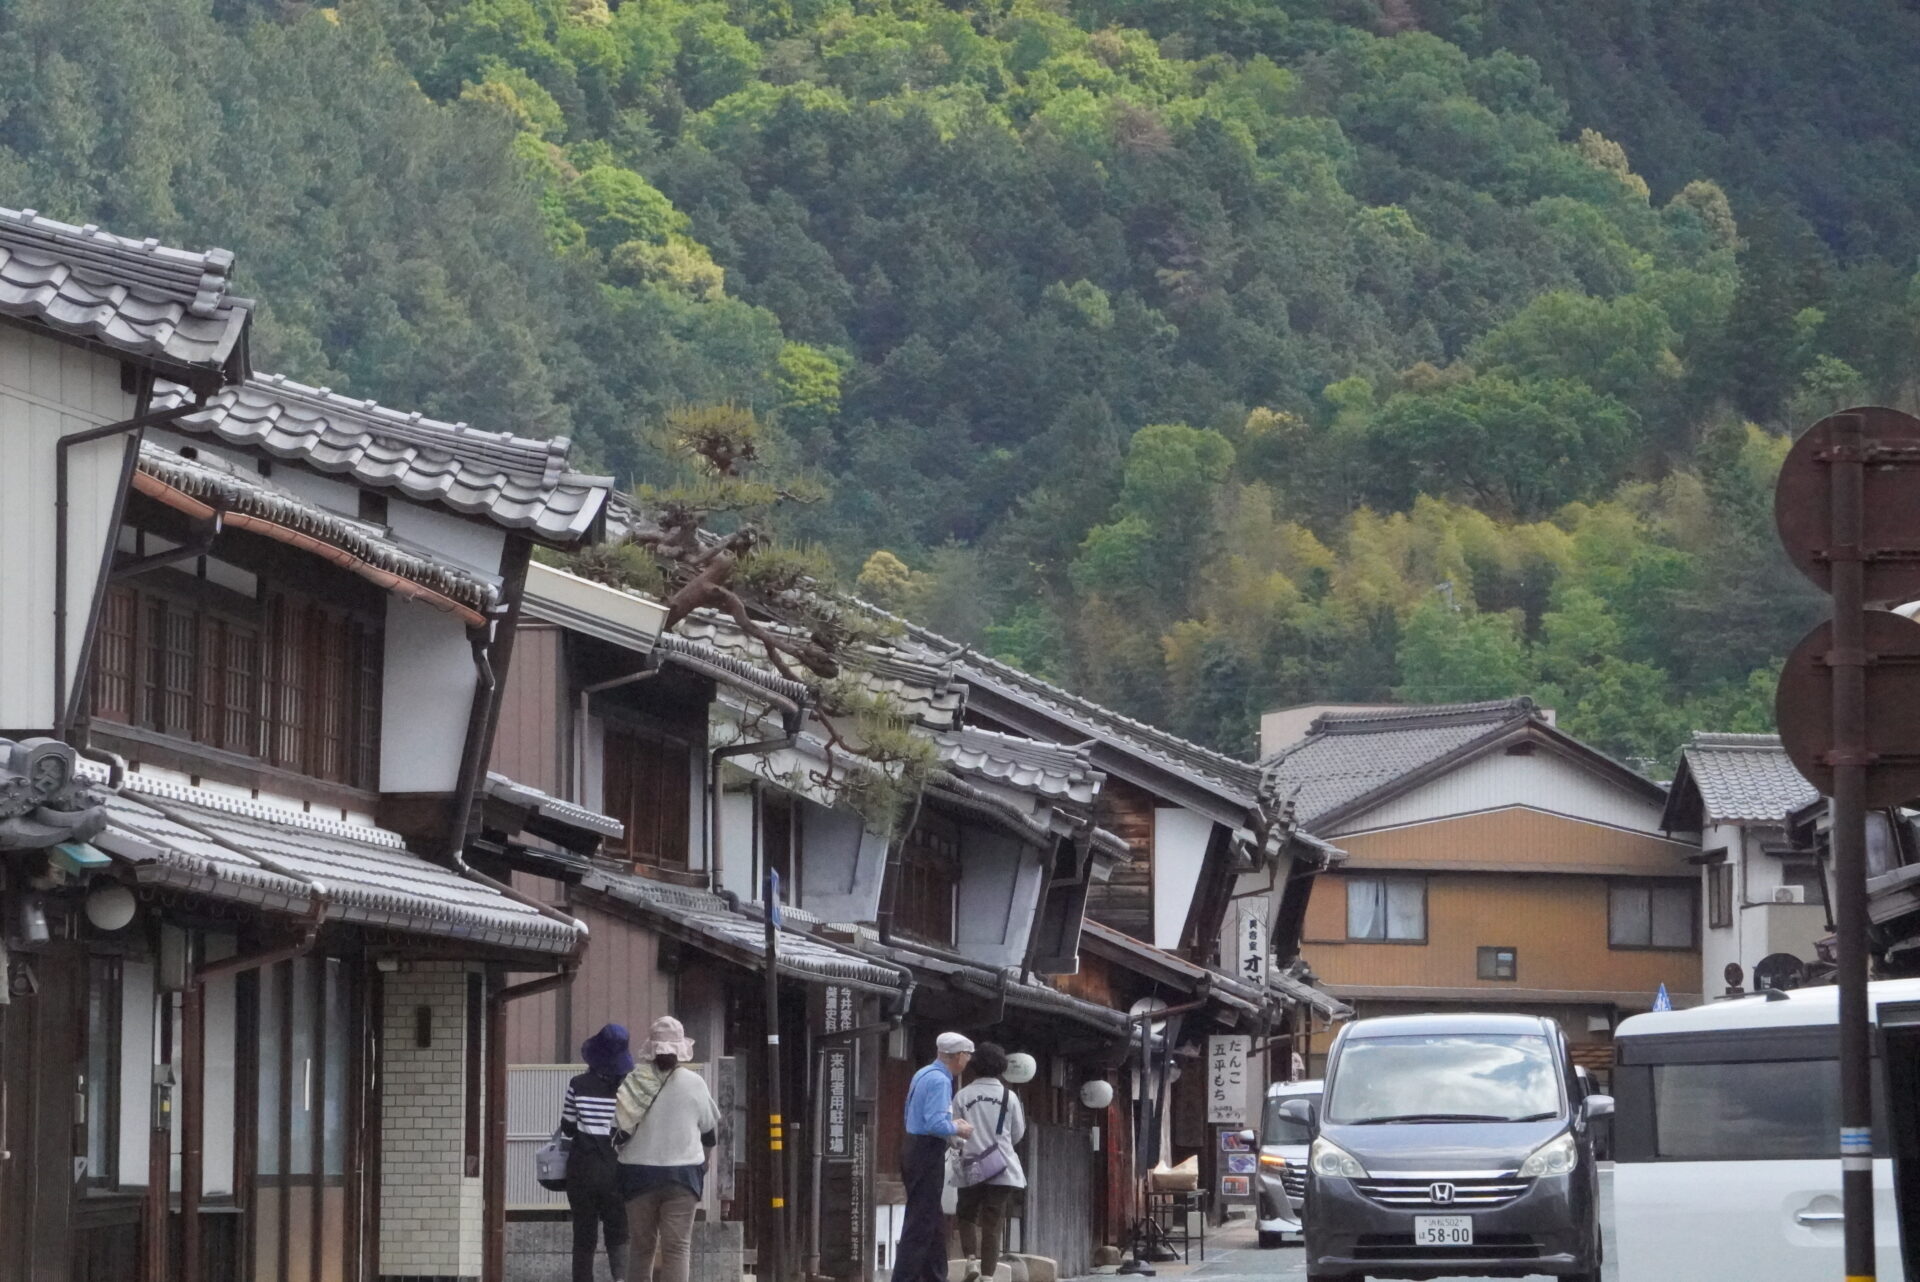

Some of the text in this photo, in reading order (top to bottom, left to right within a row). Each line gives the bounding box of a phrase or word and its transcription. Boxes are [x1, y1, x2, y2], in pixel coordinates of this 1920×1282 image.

[840, 988, 853, 1044] 今井家住
[1213, 1045, 1227, 1101] 五平もち
[829, 1053, 845, 1152] 来館者用駐車場
[1428, 1228, 1469, 1242] 58-00
